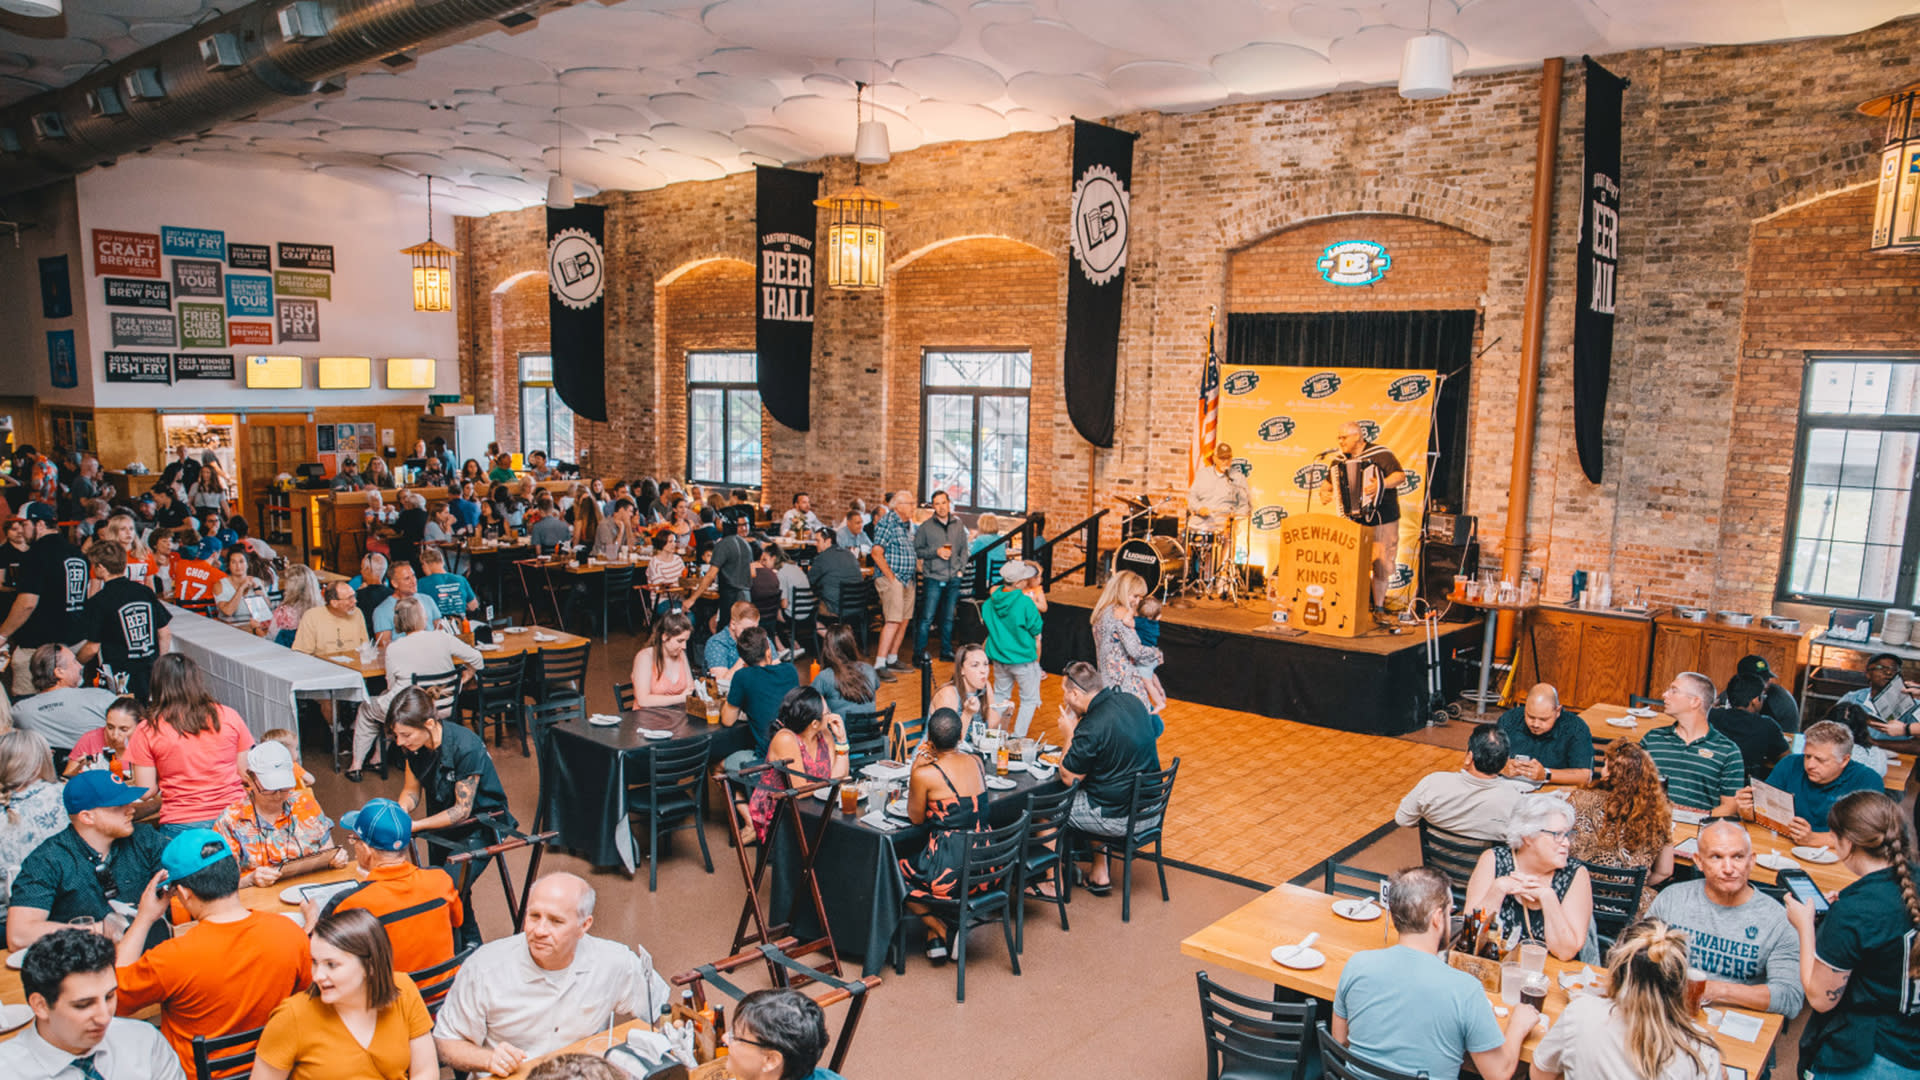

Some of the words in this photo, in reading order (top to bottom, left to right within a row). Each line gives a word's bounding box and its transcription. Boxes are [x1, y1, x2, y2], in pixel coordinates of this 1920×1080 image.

[1593, 200, 1618, 260] EER
[166, 236, 194, 248] FISH
[199, 238, 221, 249] FRY
[99, 241, 155, 258] CRAFT
[281, 251, 308, 260] CRAFT
[310, 253, 332, 261] BEER
[100, 255, 156, 268] BREWERY
[762, 250, 812, 288] BEER
[178, 275, 217, 288] TOUR
[110, 287, 143, 298] BREW
[145, 289, 168, 300] PUB
[232, 295, 268, 308] TOUR
[762, 286, 814, 322] HALL
[183, 311, 221, 321] FRIED
[281, 305, 316, 320] FISH
[137, 318, 173, 326] WINNER
[183, 321, 221, 330] CHEESE
[281, 319, 316, 334] FRY
[183, 329, 223, 339] CURDS
[231, 329, 269, 337] BREWPUB
[109, 355, 129, 363] 2018
[131, 356, 167, 364] WINNER
[109, 362, 140, 374] FISH
[143, 363, 168, 375] FRY
[1282, 526, 1358, 550] BREWHAUS
[1296, 549, 1340, 566] POLKA
[185, 566, 210, 581] CHOO
[1296, 568, 1338, 585] KINGS
[181, 580, 208, 601] 17
